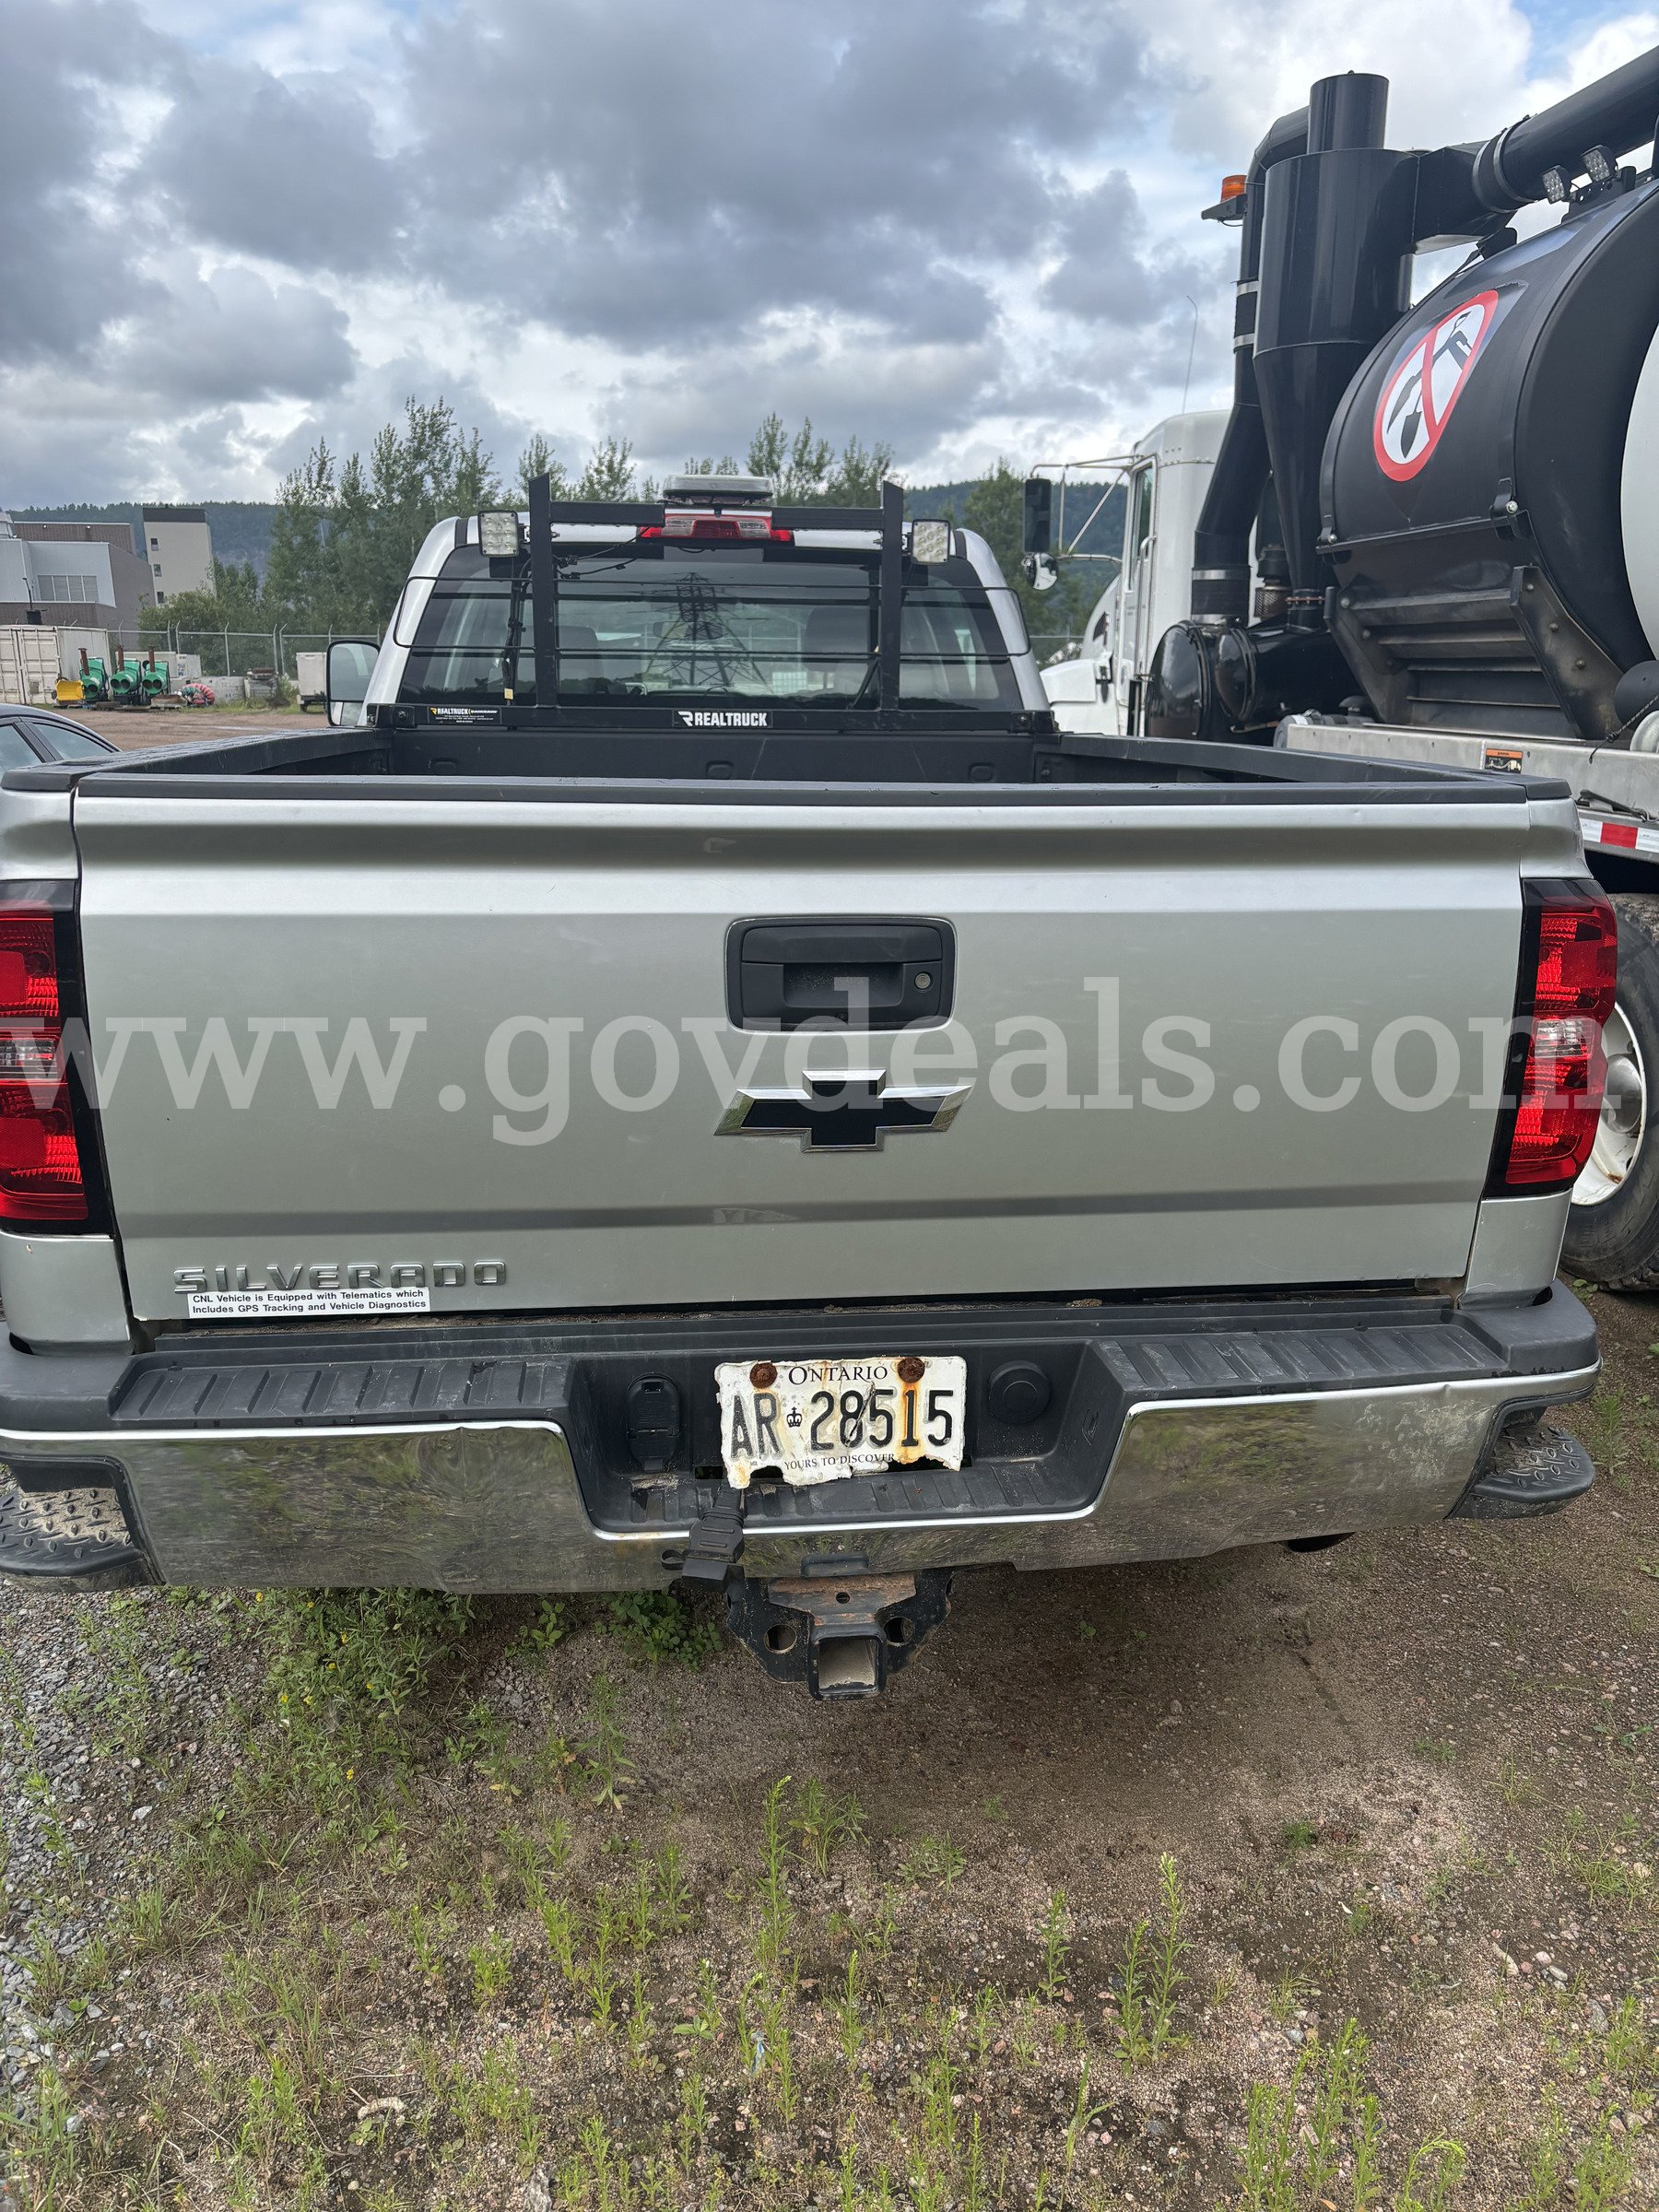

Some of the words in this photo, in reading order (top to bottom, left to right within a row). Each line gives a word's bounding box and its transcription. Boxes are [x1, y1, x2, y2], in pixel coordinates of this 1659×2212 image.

[694, 712, 768, 726] REALTRUCK
[173, 1259, 508, 1294] SILVERADO
[193, 1295, 213, 1303] CNL
[217, 1294, 252, 1302] Vehicle
[267, 1292, 312, 1302] Equipped
[317, 1291, 337, 1300] with
[340, 1290, 393, 1300] Telematics
[395, 1289, 424, 1298] which
[193, 1304, 234, 1313] Includes
[238, 1304, 259, 1312] GPS
[263, 1303, 304, 1312] Tracking
[308, 1302, 326, 1311] and
[329, 1301, 365, 1310] Vehicle
[369, 1300, 427, 1310] Diagnostics
[788, 1366, 888, 1385] ONTARIO
[730, 1392, 781, 1460] AR
[810, 1389, 955, 1452] 28515
[784, 1457, 818, 1471] YOURS
[821, 1456, 836, 1466] TO
[840, 1453, 895, 1465] DISCOVER
